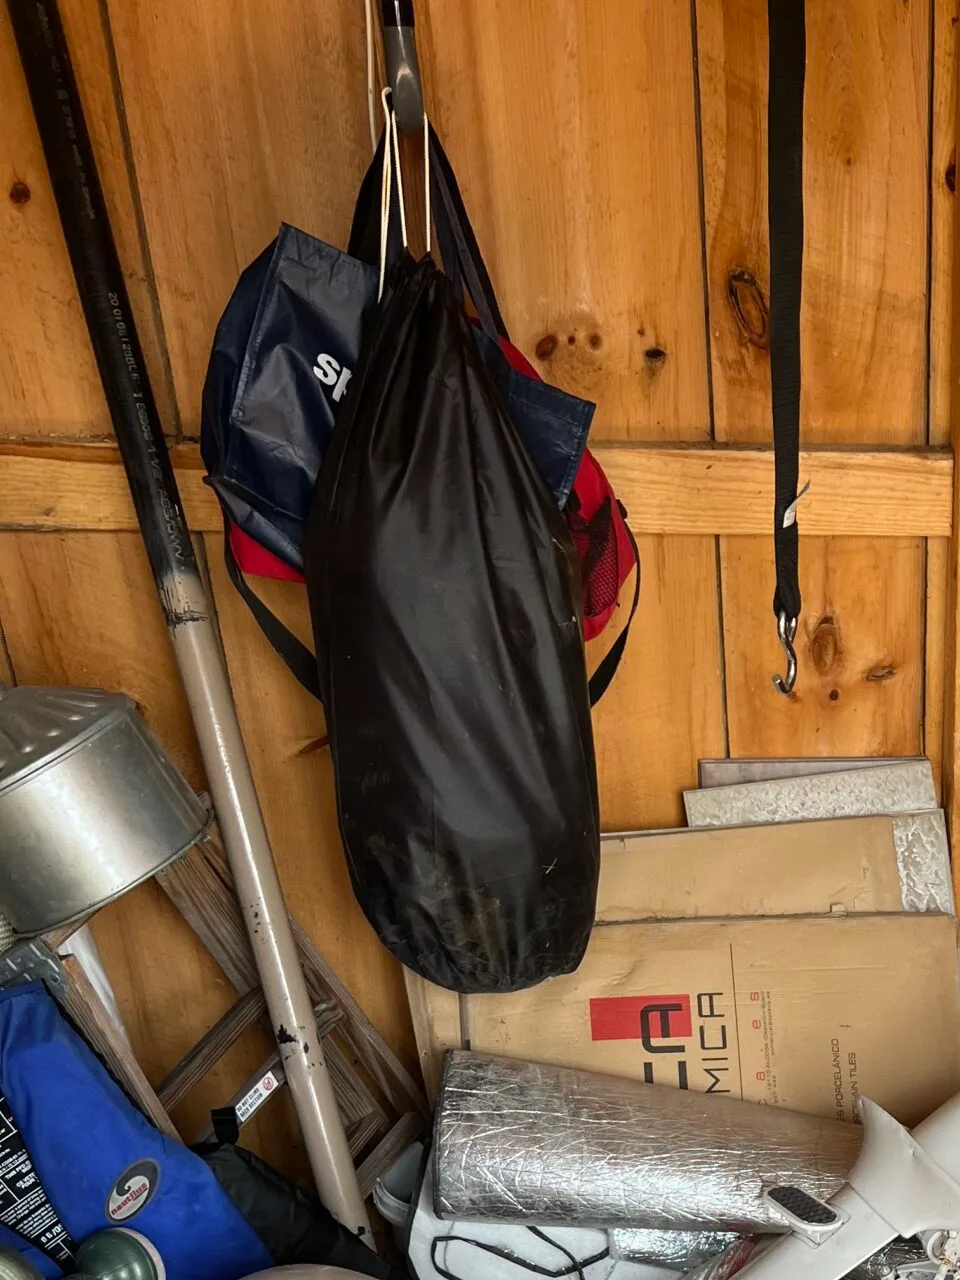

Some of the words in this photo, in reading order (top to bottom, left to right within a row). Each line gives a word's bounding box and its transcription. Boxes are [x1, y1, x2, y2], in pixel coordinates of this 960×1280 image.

[830, 1038, 843, 1107] PORCELÁNICO
[847, 1052, 856, 1077] TILES
[241, 1098, 250, 1107] NOT
[248, 1087, 260, 1100] CLIMB
